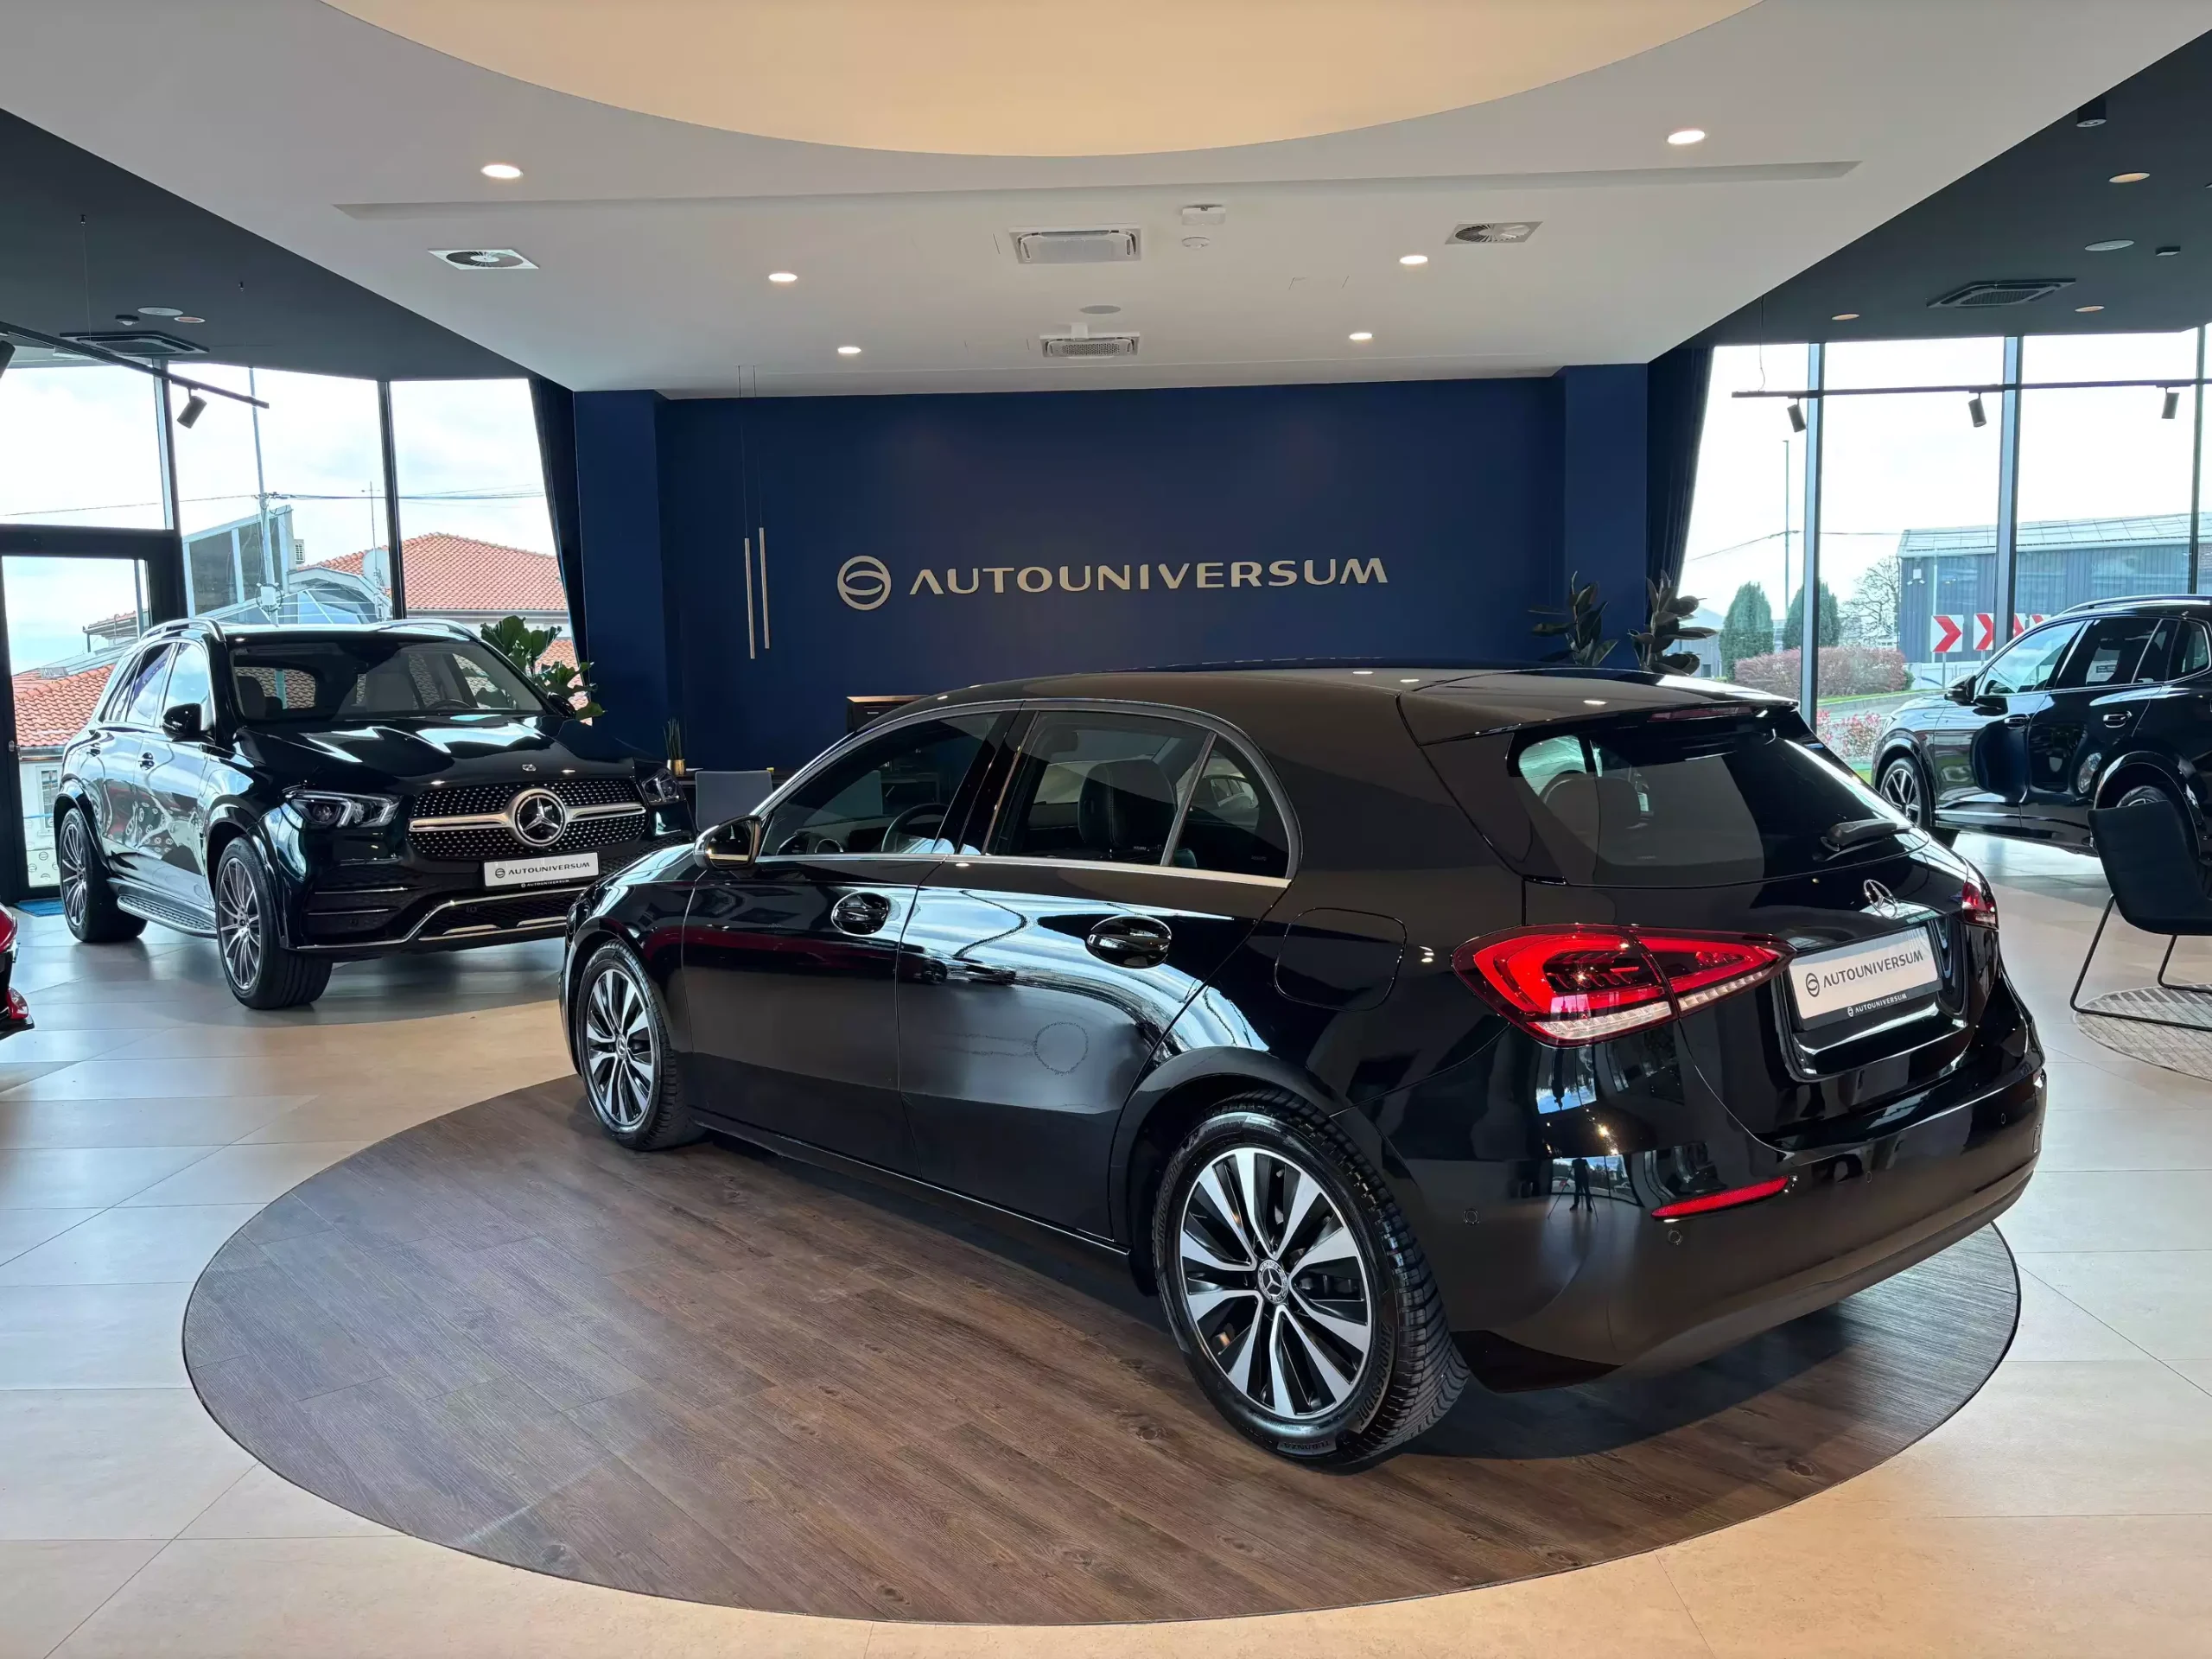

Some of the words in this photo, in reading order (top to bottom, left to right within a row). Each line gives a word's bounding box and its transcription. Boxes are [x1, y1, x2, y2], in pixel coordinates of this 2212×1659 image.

[909, 556, 1389, 595] AUTOUNIVERSUM
[508, 862, 590, 874] AUTOUNIVERSUM
[1823, 950, 1923, 988] AUTOUNIVERSUM
[1855, 994, 1907, 1013] AUTOUNIVERSUM
